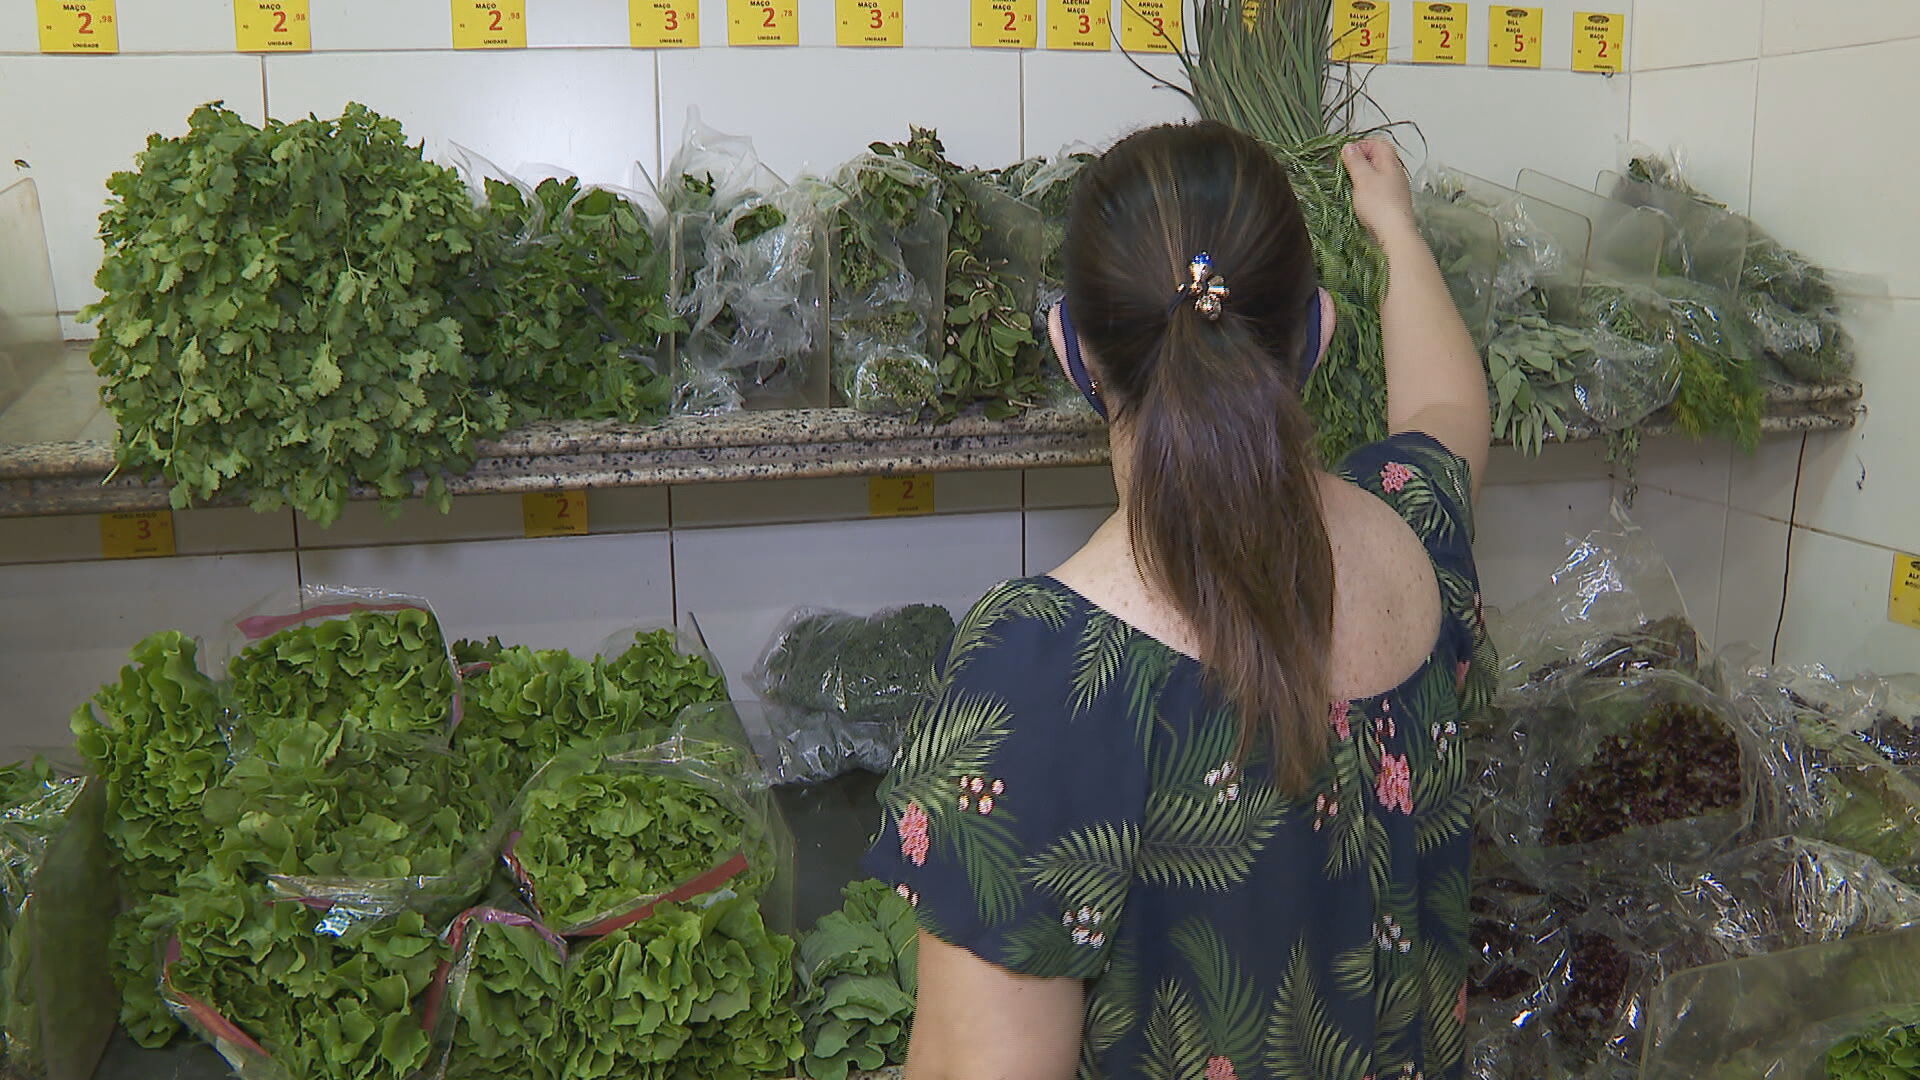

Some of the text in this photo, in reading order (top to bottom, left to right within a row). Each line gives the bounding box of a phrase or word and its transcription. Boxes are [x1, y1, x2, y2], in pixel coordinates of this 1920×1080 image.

[78, 12, 94, 34] 2
[273, 11, 288, 32] 2
[488, 10, 503, 30] 2
[664, 10, 678, 30] 3
[762, 8, 776, 28] 2
[870, 10, 882, 29] 3
[1004, 12, 1016, 31] 2
[1078, 14, 1090, 34] 3
[1152, 18, 1164, 36] 3
[1360, 29, 1370, 47] 3
[1440, 30, 1450, 48] 2
[1514, 34, 1524, 52] 5
[1598, 40, 1608, 58] 2
[902, 480, 914, 499] 2
[556, 498, 570, 518] 2
[137, 520, 151, 540] 3
